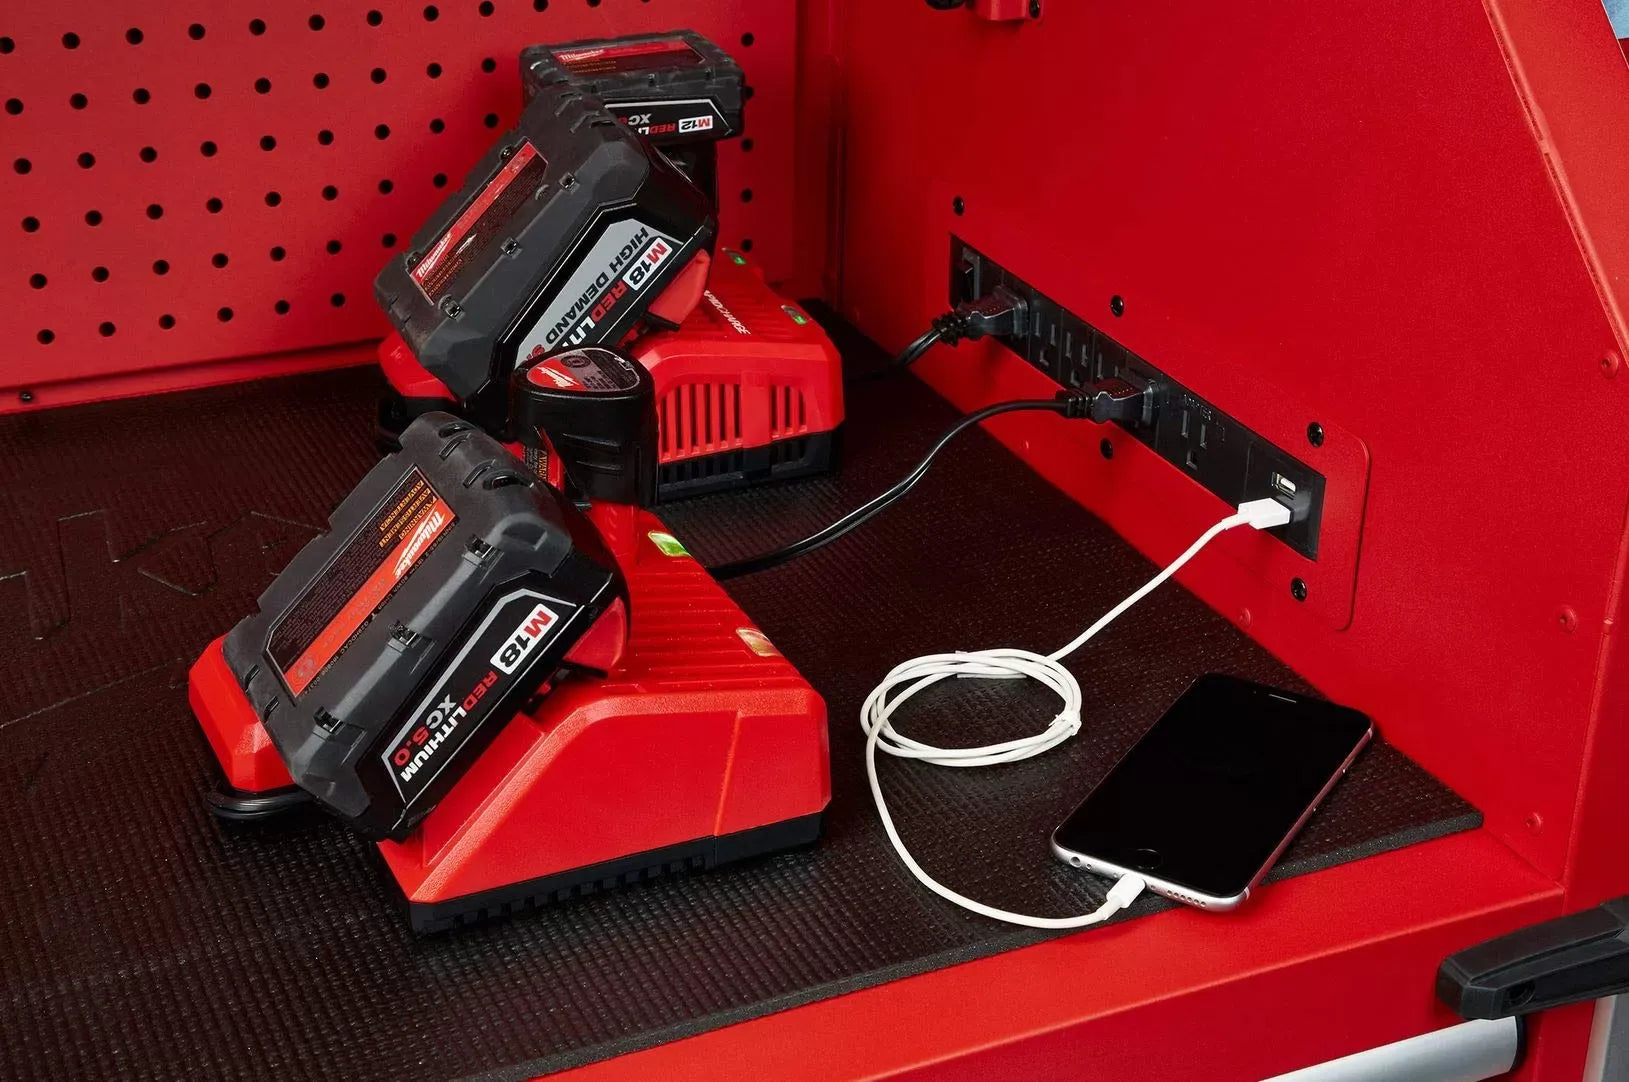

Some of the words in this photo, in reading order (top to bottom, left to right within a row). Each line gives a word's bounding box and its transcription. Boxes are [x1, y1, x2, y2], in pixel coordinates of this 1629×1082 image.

[681, 117, 711, 131] M12
[415, 232, 452, 284] Milwaukee
[609, 226, 649, 274] HIGH
[629, 242, 668, 286] M18
[545, 271, 610, 345] DEMAND
[562, 280, 628, 347] REDLIT
[392, 505, 446, 580] Milwaukee
[399, 500, 433, 540] WARNING
[499, 610, 553, 668] M18
[393, 693, 457, 767] XC5.0
[400, 670, 498, 782] REDLITHIUM
